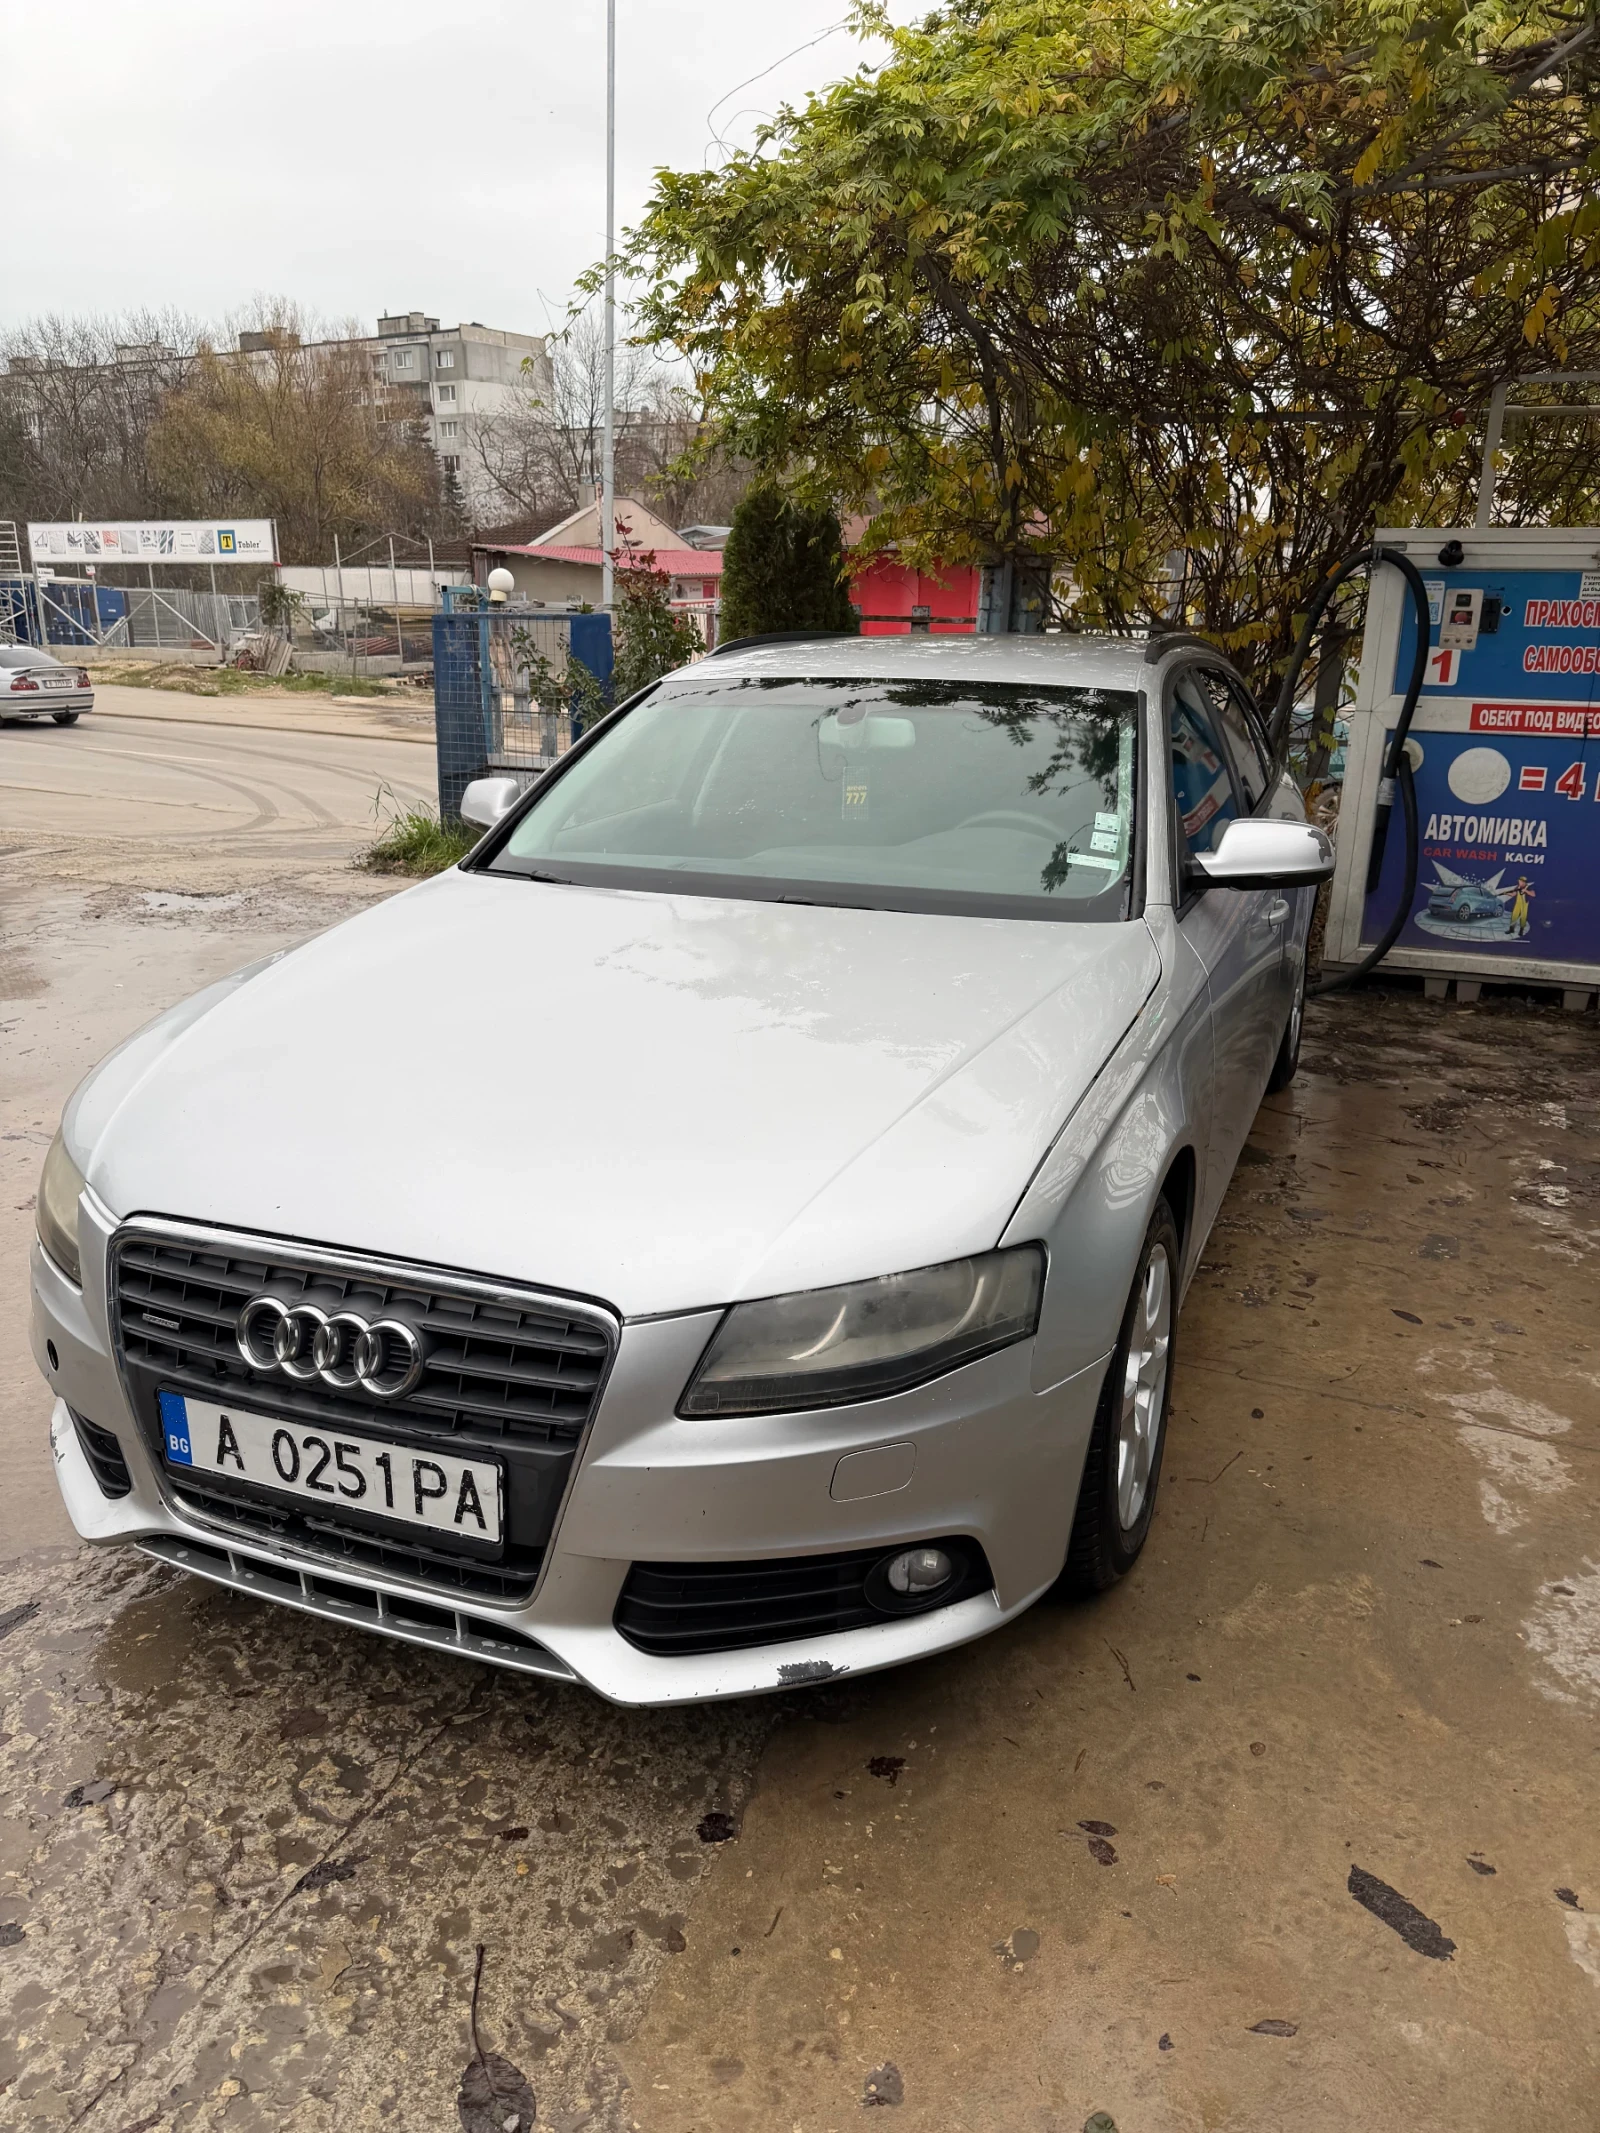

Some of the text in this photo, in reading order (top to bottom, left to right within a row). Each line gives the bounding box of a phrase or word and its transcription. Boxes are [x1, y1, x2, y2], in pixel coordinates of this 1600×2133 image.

[222, 535, 231, 548] T
[1432, 650, 1452, 682] 1
[1479, 709, 1522, 727] ОБЕКТ
[1524, 710, 1554, 731] ПОД
[846, 792, 867, 805] 777
[1424, 813, 1547, 848] АВТОМИВКА
[1423, 846, 1498, 861] CAR WASH
[1505, 852, 1545, 864] КАСИ
[169, 1434, 189, 1454] BG
[217, 1413, 246, 1471] A
